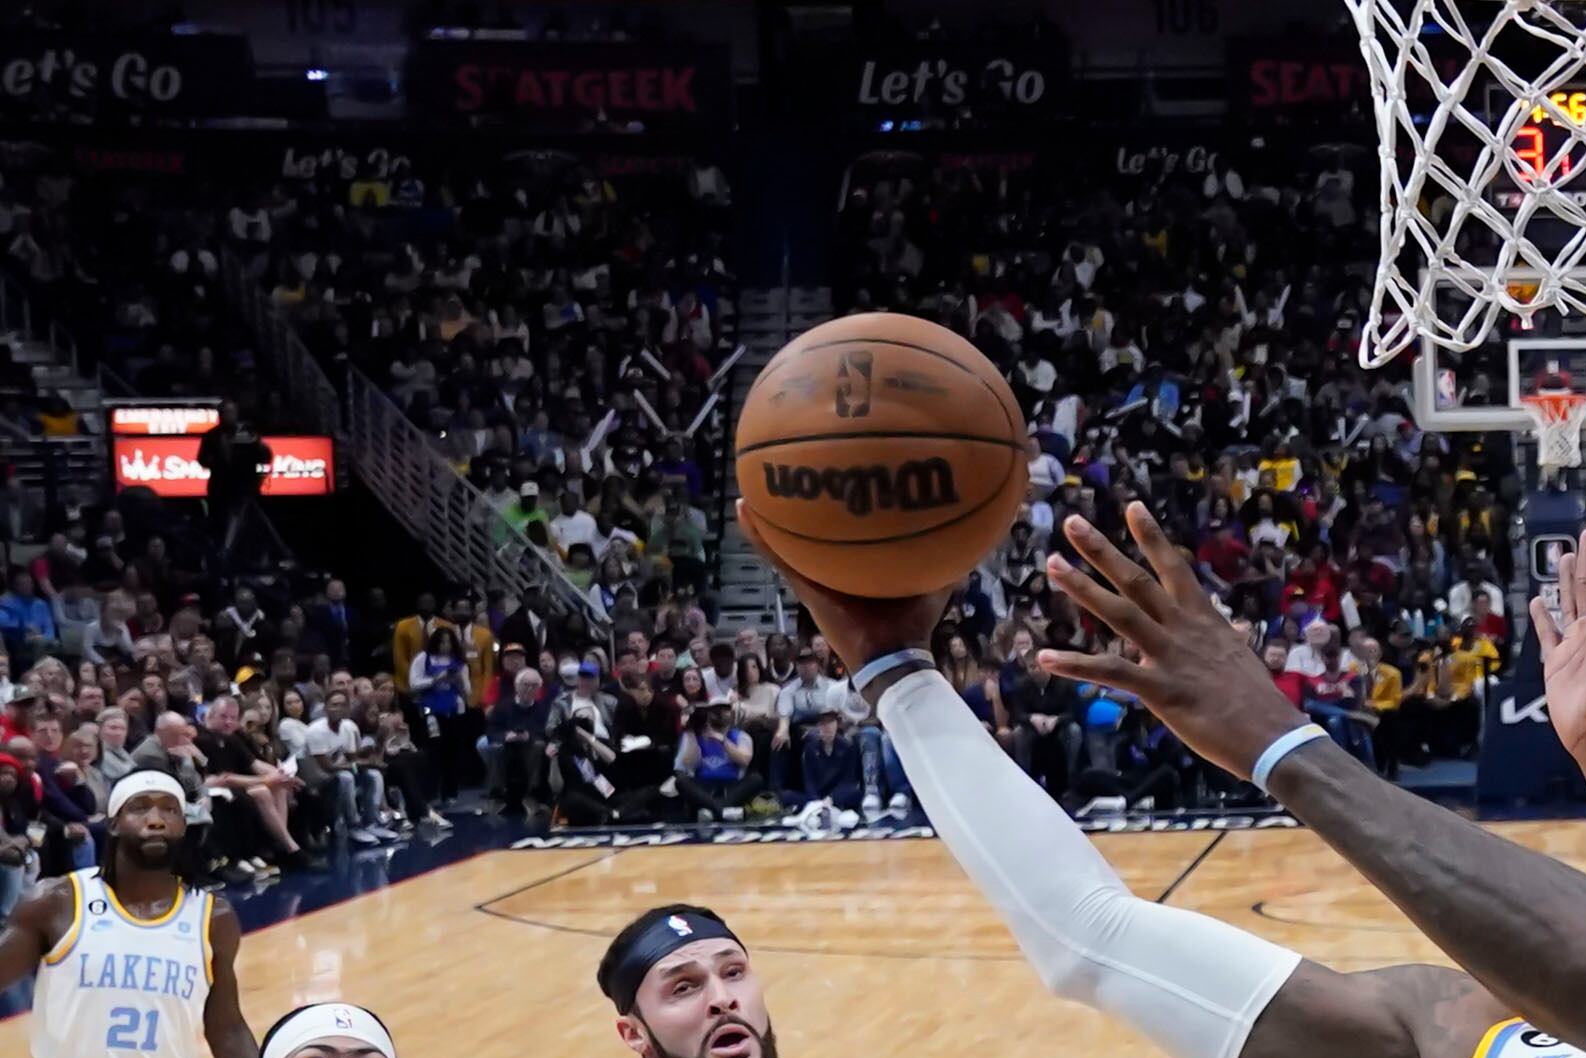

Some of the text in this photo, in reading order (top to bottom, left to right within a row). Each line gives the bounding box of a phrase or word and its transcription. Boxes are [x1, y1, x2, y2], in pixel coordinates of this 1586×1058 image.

[1, 49, 98, 98] et's
[857, 58, 969, 106] Let's
[763, 457, 960, 517] Wilson
[78, 953, 198, 1001] LAKERS
[106, 1006, 160, 1052] 21
